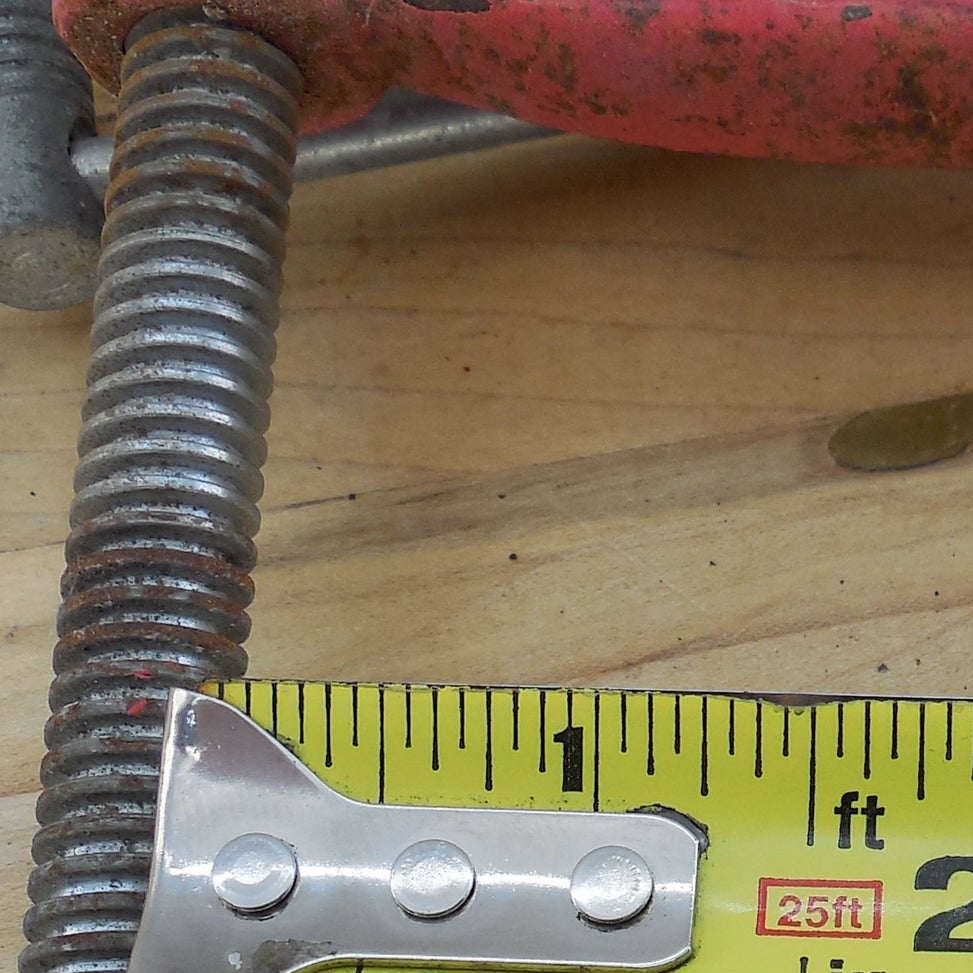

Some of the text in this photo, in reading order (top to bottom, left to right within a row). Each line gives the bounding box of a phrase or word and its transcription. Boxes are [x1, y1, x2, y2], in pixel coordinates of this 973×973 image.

[553, 726, 584, 793] 1
[834, 791, 886, 850] ft
[776, 894, 863, 930] 25ft
